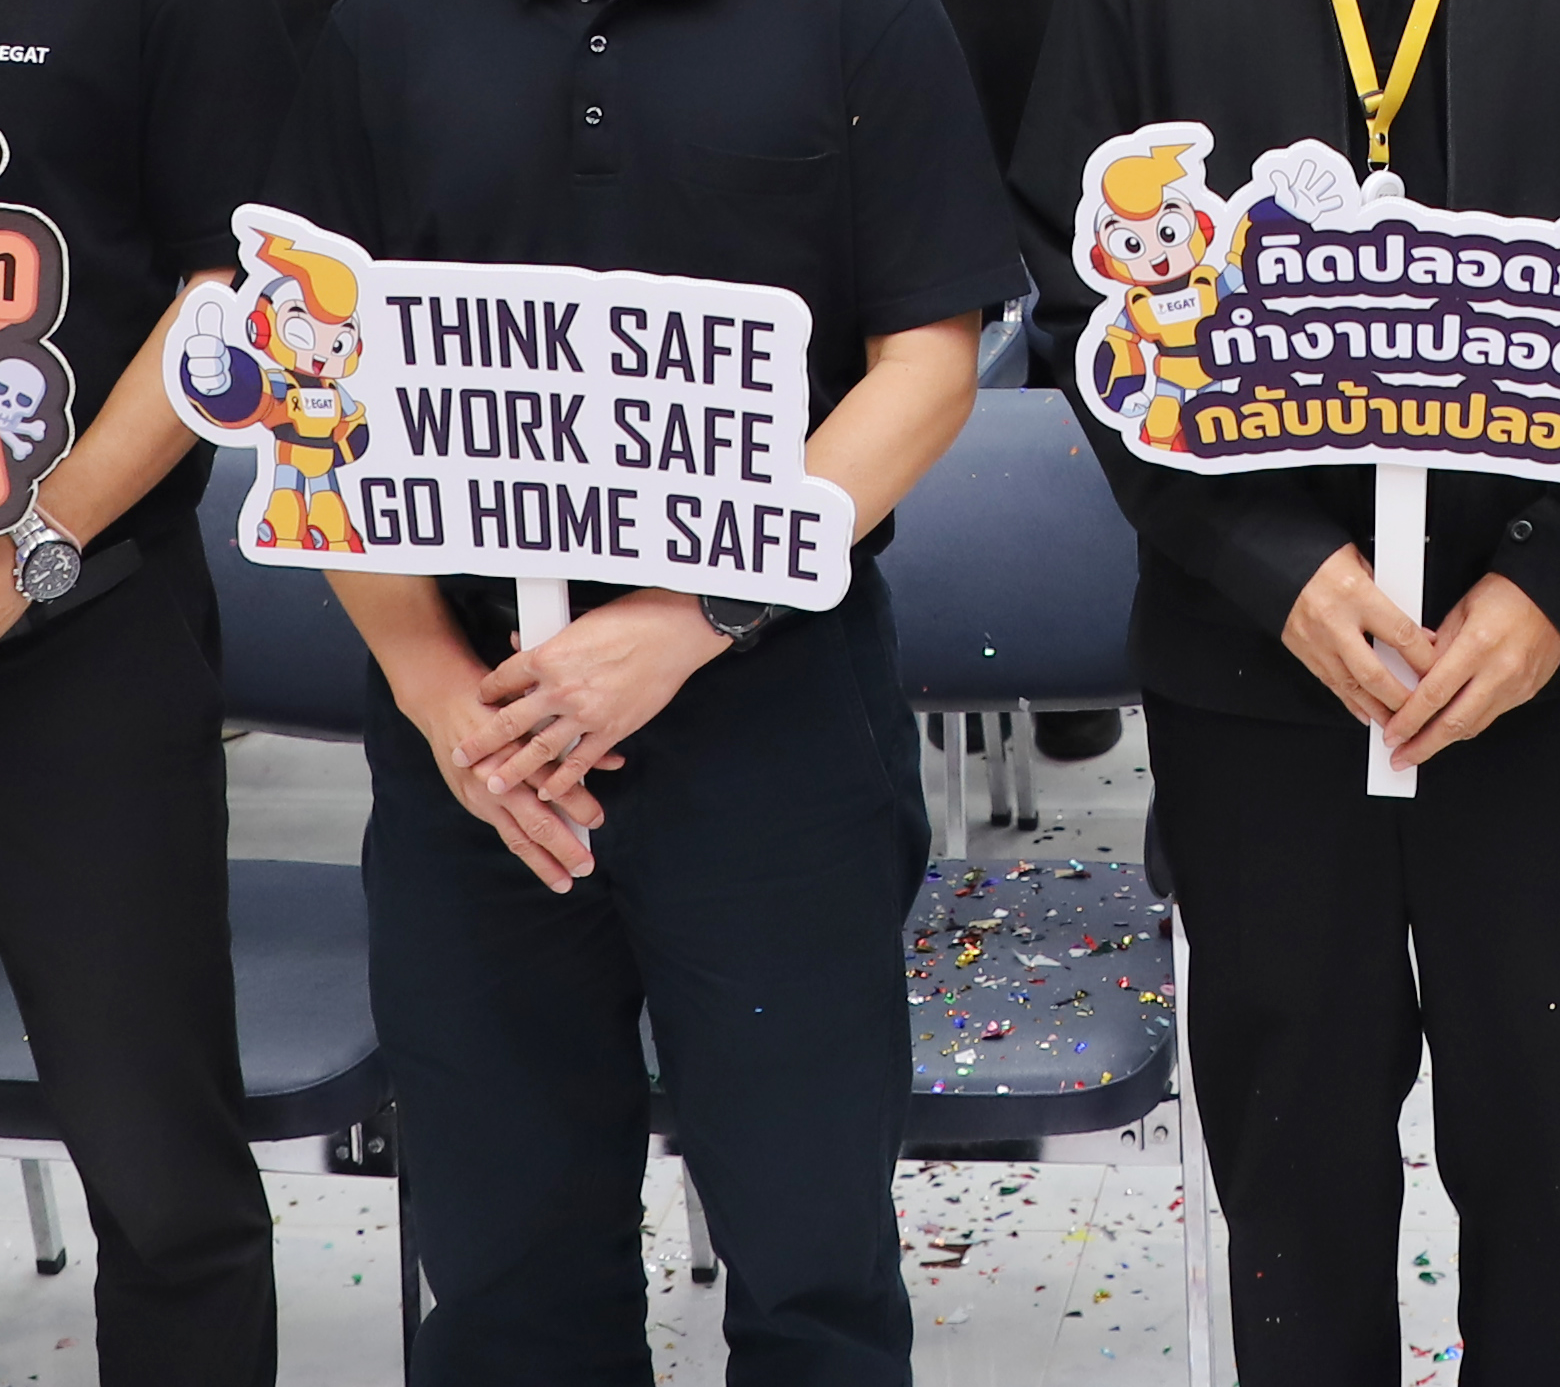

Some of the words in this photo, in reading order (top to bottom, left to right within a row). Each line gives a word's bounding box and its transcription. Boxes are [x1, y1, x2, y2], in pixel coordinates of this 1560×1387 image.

[385, 295, 586, 373] THINK
[610, 305, 775, 393] SAFE
[1166, 297, 1196, 312] EGAT
[311, 398, 333, 409] EGAT
[396, 387, 590, 465] WORK
[615, 397, 774, 484] SAFE
[360, 477, 445, 547] GO
[468, 479, 640, 560] HOME
[665, 493, 821, 582] SAFE
